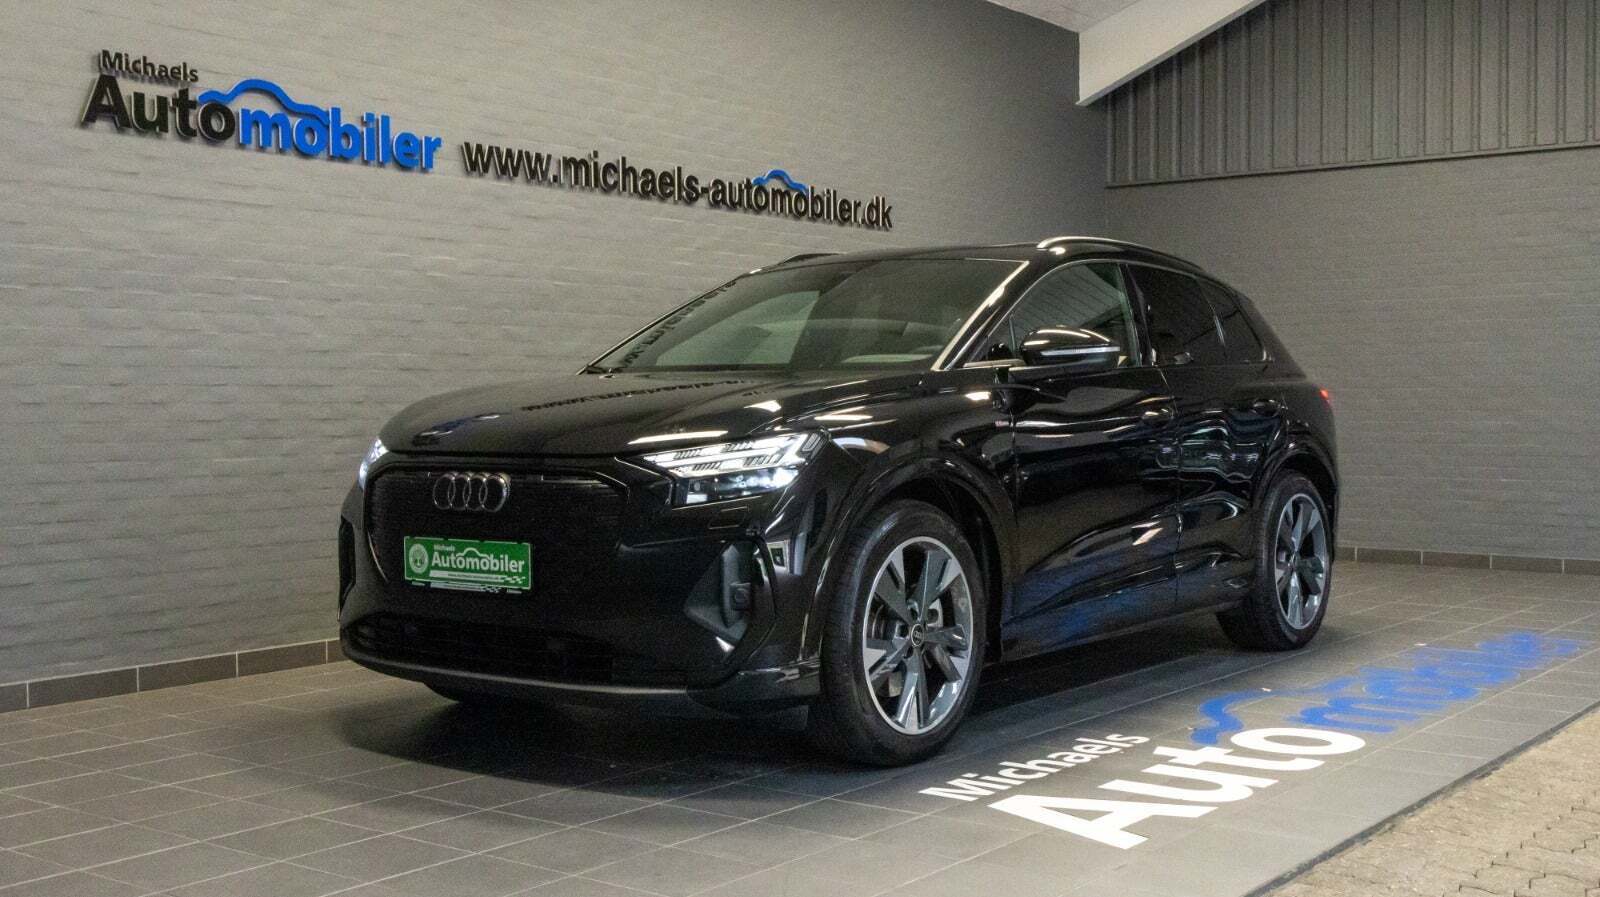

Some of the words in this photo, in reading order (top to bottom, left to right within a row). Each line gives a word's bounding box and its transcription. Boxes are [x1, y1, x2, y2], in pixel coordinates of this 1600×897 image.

[98, 49, 199, 83] Michaels
[81, 74, 443, 171] Automobiler
[461, 141, 893, 230] www.michaels-automobiler.dk
[431, 551, 525, 573] Automobiler
[919, 730, 1151, 802] Michaels
